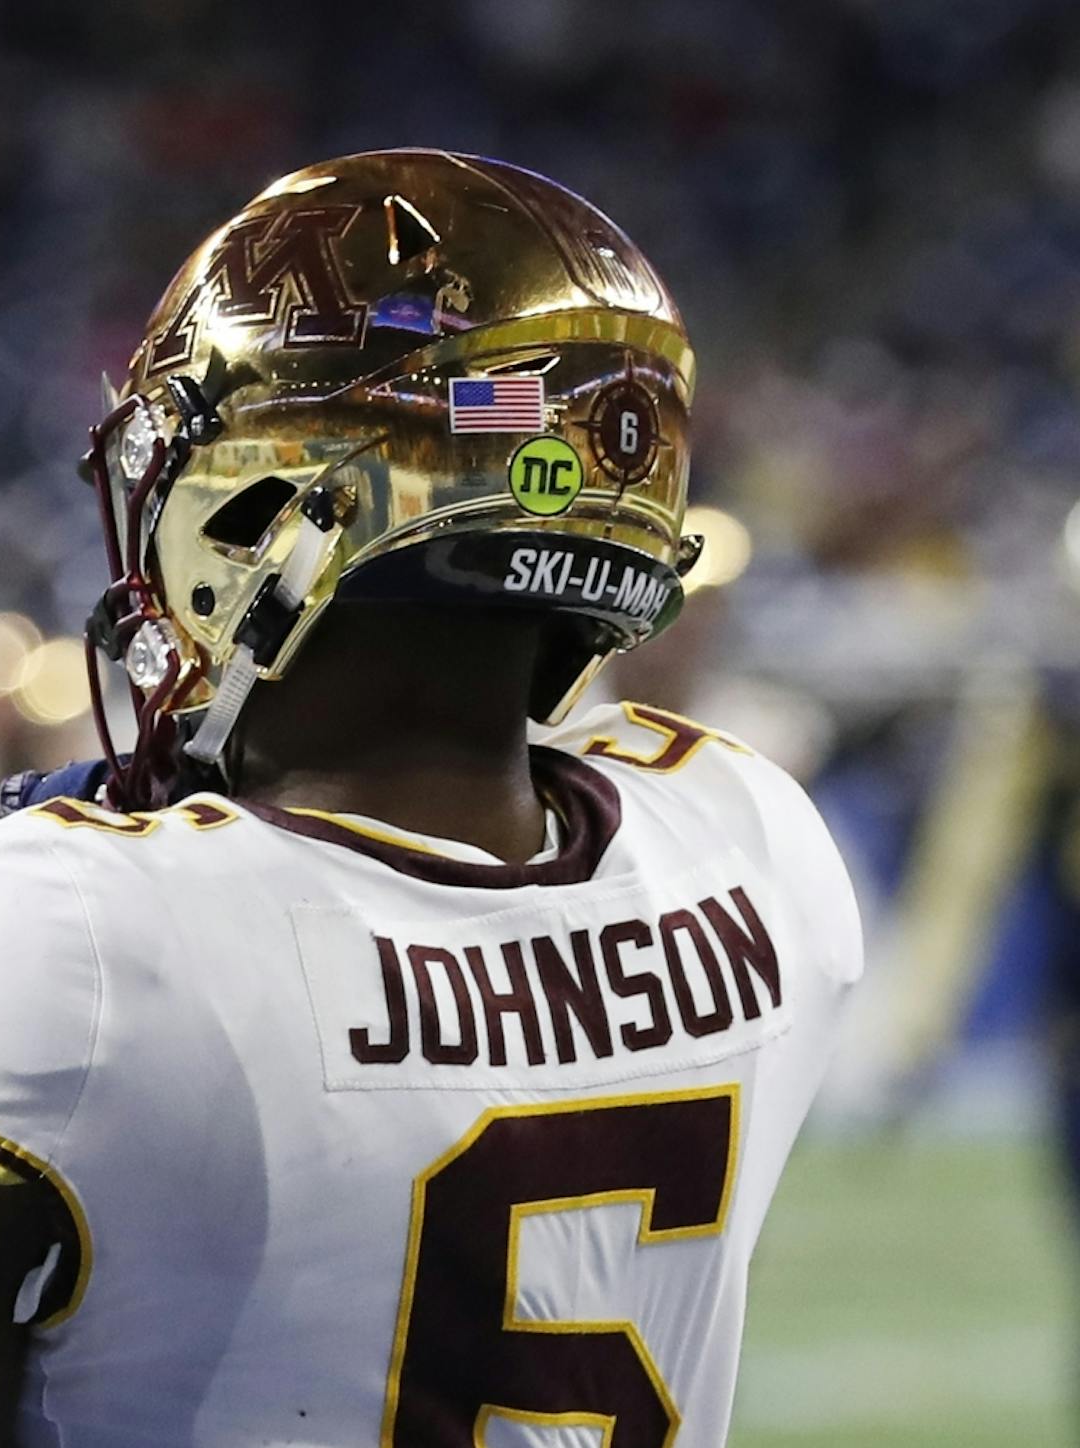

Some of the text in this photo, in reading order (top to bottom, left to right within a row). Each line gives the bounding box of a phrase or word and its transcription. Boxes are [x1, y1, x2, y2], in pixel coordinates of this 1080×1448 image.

[147, 205, 369, 380] M
[620, 411, 639, 455] 6
[504, 548, 670, 624] SKI-U-MAH
[349, 887, 782, 1066] JOHNSON
